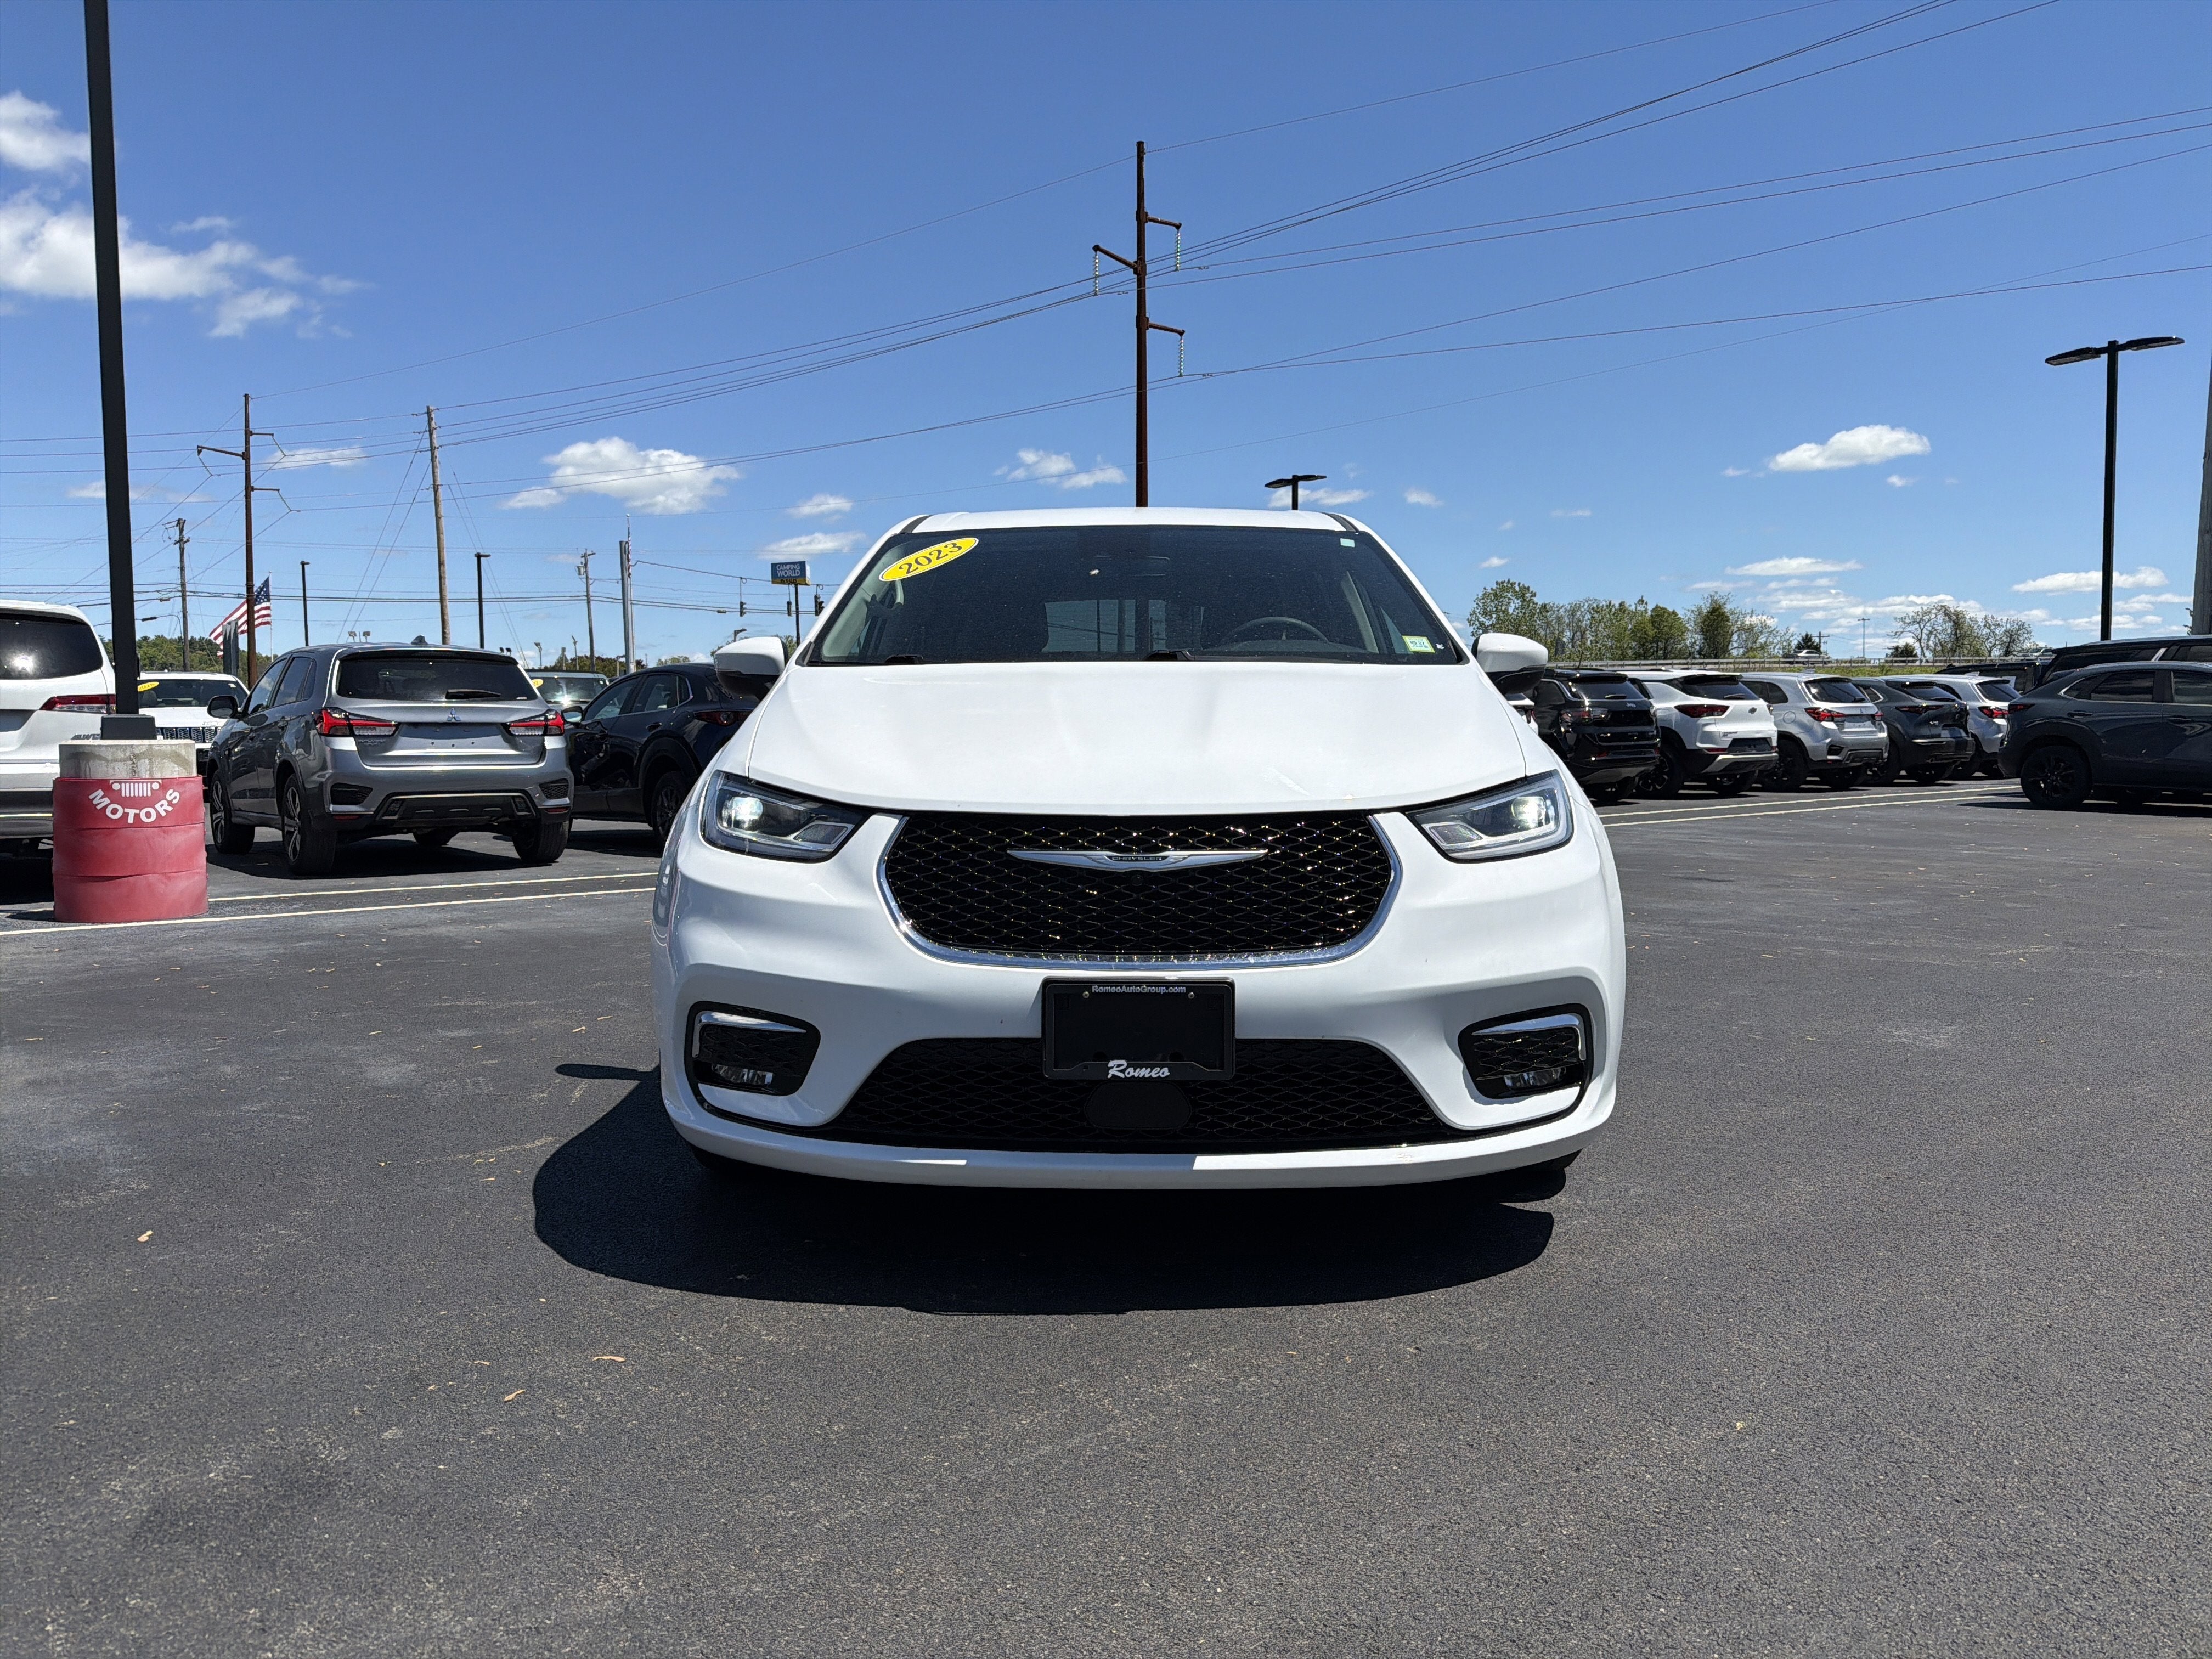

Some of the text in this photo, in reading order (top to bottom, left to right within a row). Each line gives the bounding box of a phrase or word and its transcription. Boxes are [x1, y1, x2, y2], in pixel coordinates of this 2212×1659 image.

[899, 543, 962, 574] 2023
[88, 789, 180, 823] MOTORS
[1092, 985, 1186, 994] RomeoAutoGroup.com
[1107, 1059, 1170, 1079] Romeo
